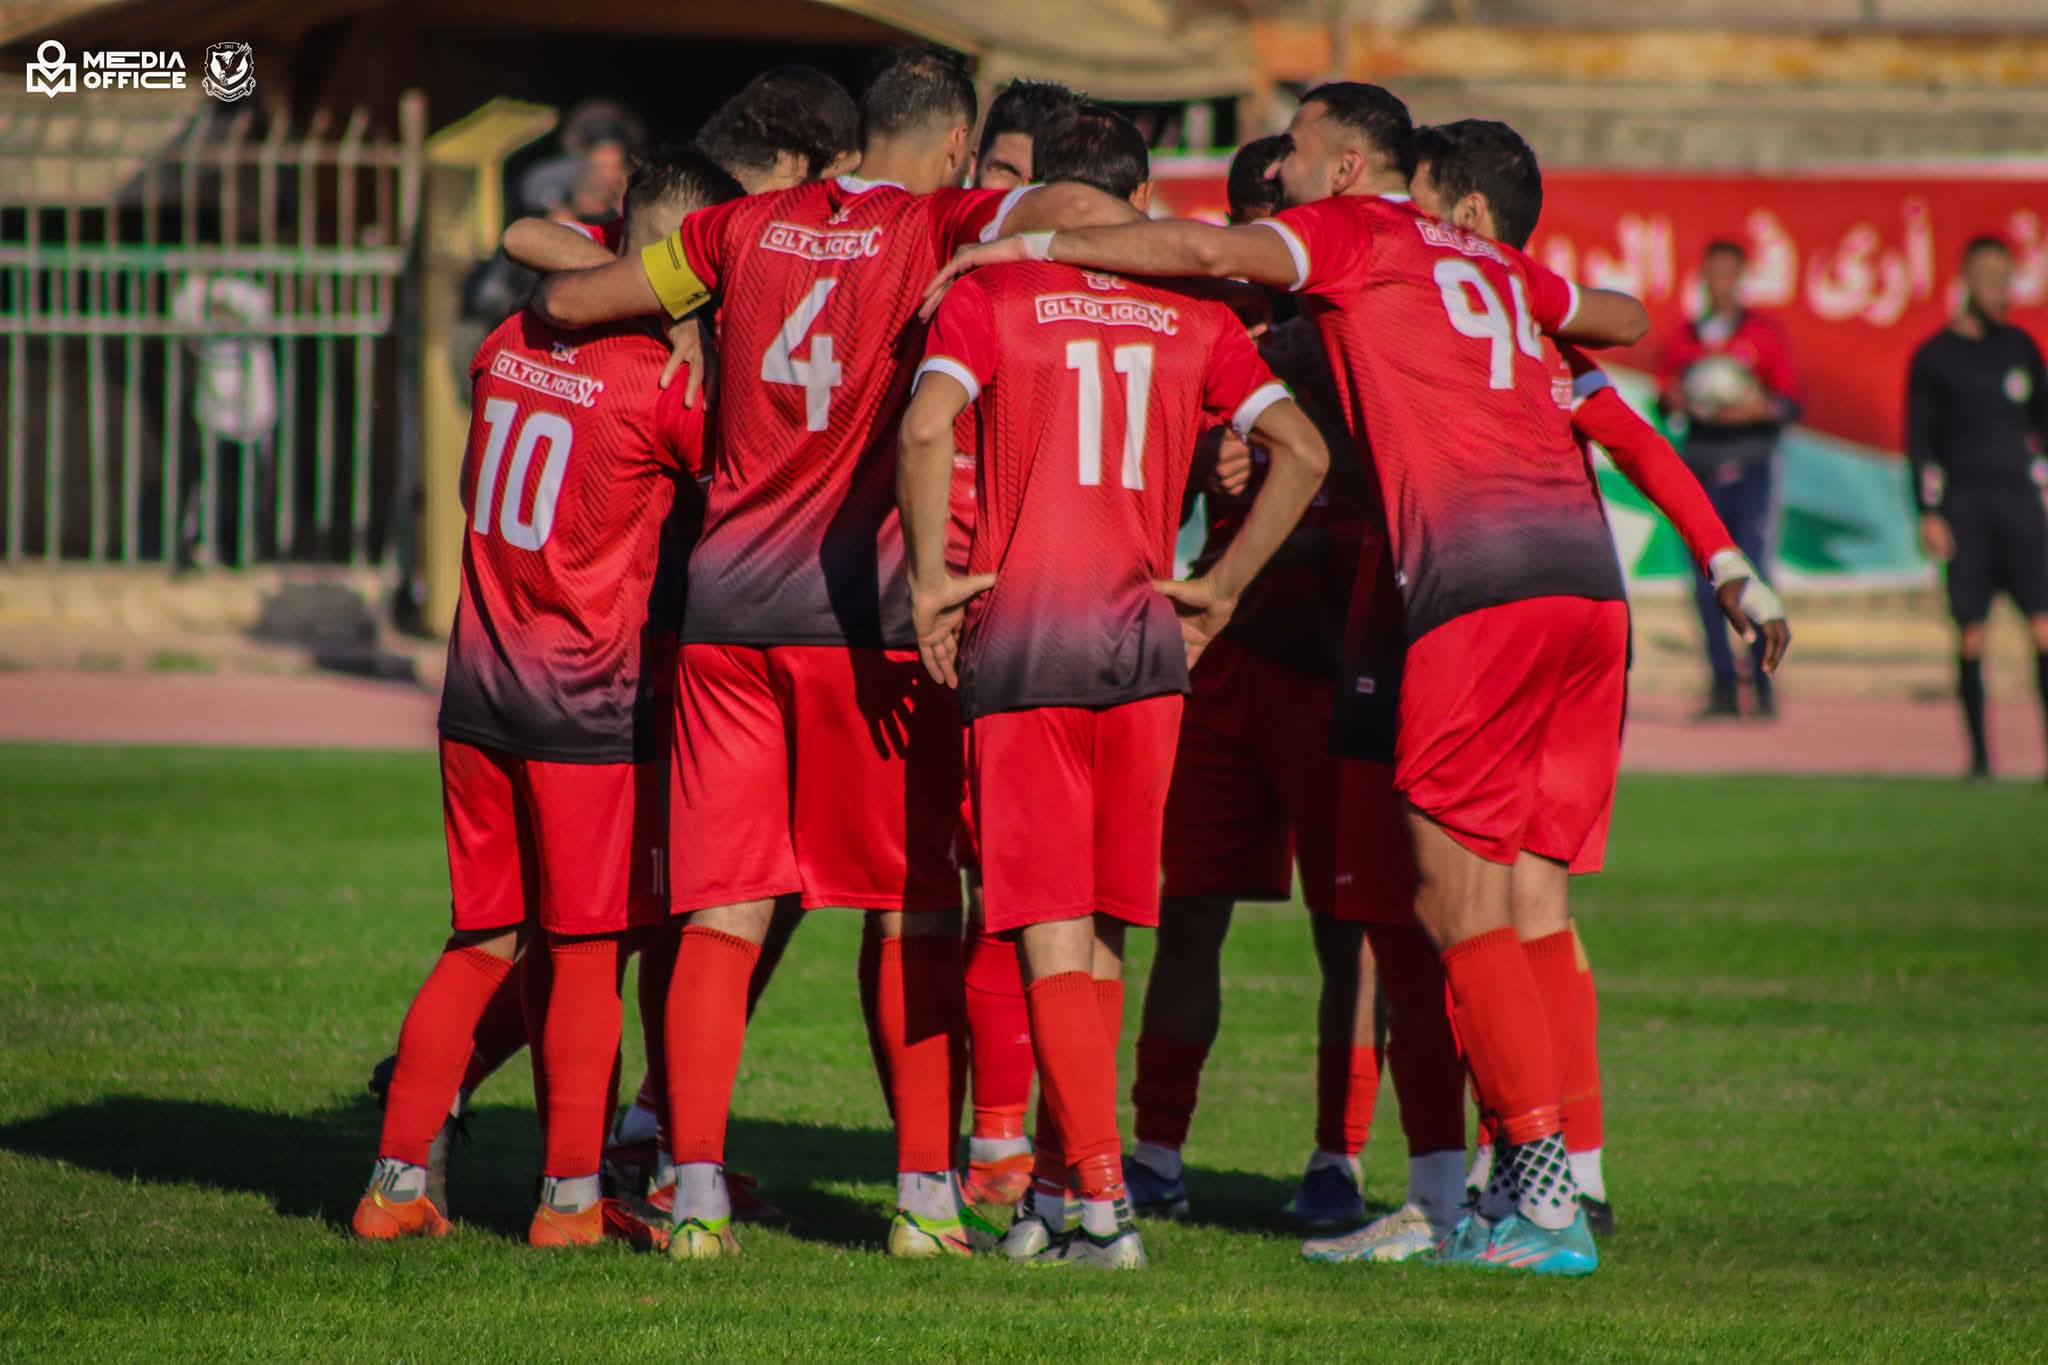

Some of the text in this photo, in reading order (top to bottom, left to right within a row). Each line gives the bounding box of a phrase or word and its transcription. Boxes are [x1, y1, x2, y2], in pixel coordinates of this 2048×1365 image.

[761, 277, 842, 431] 4
[1065, 340, 1154, 491] 11
[473, 397, 574, 552] 10
